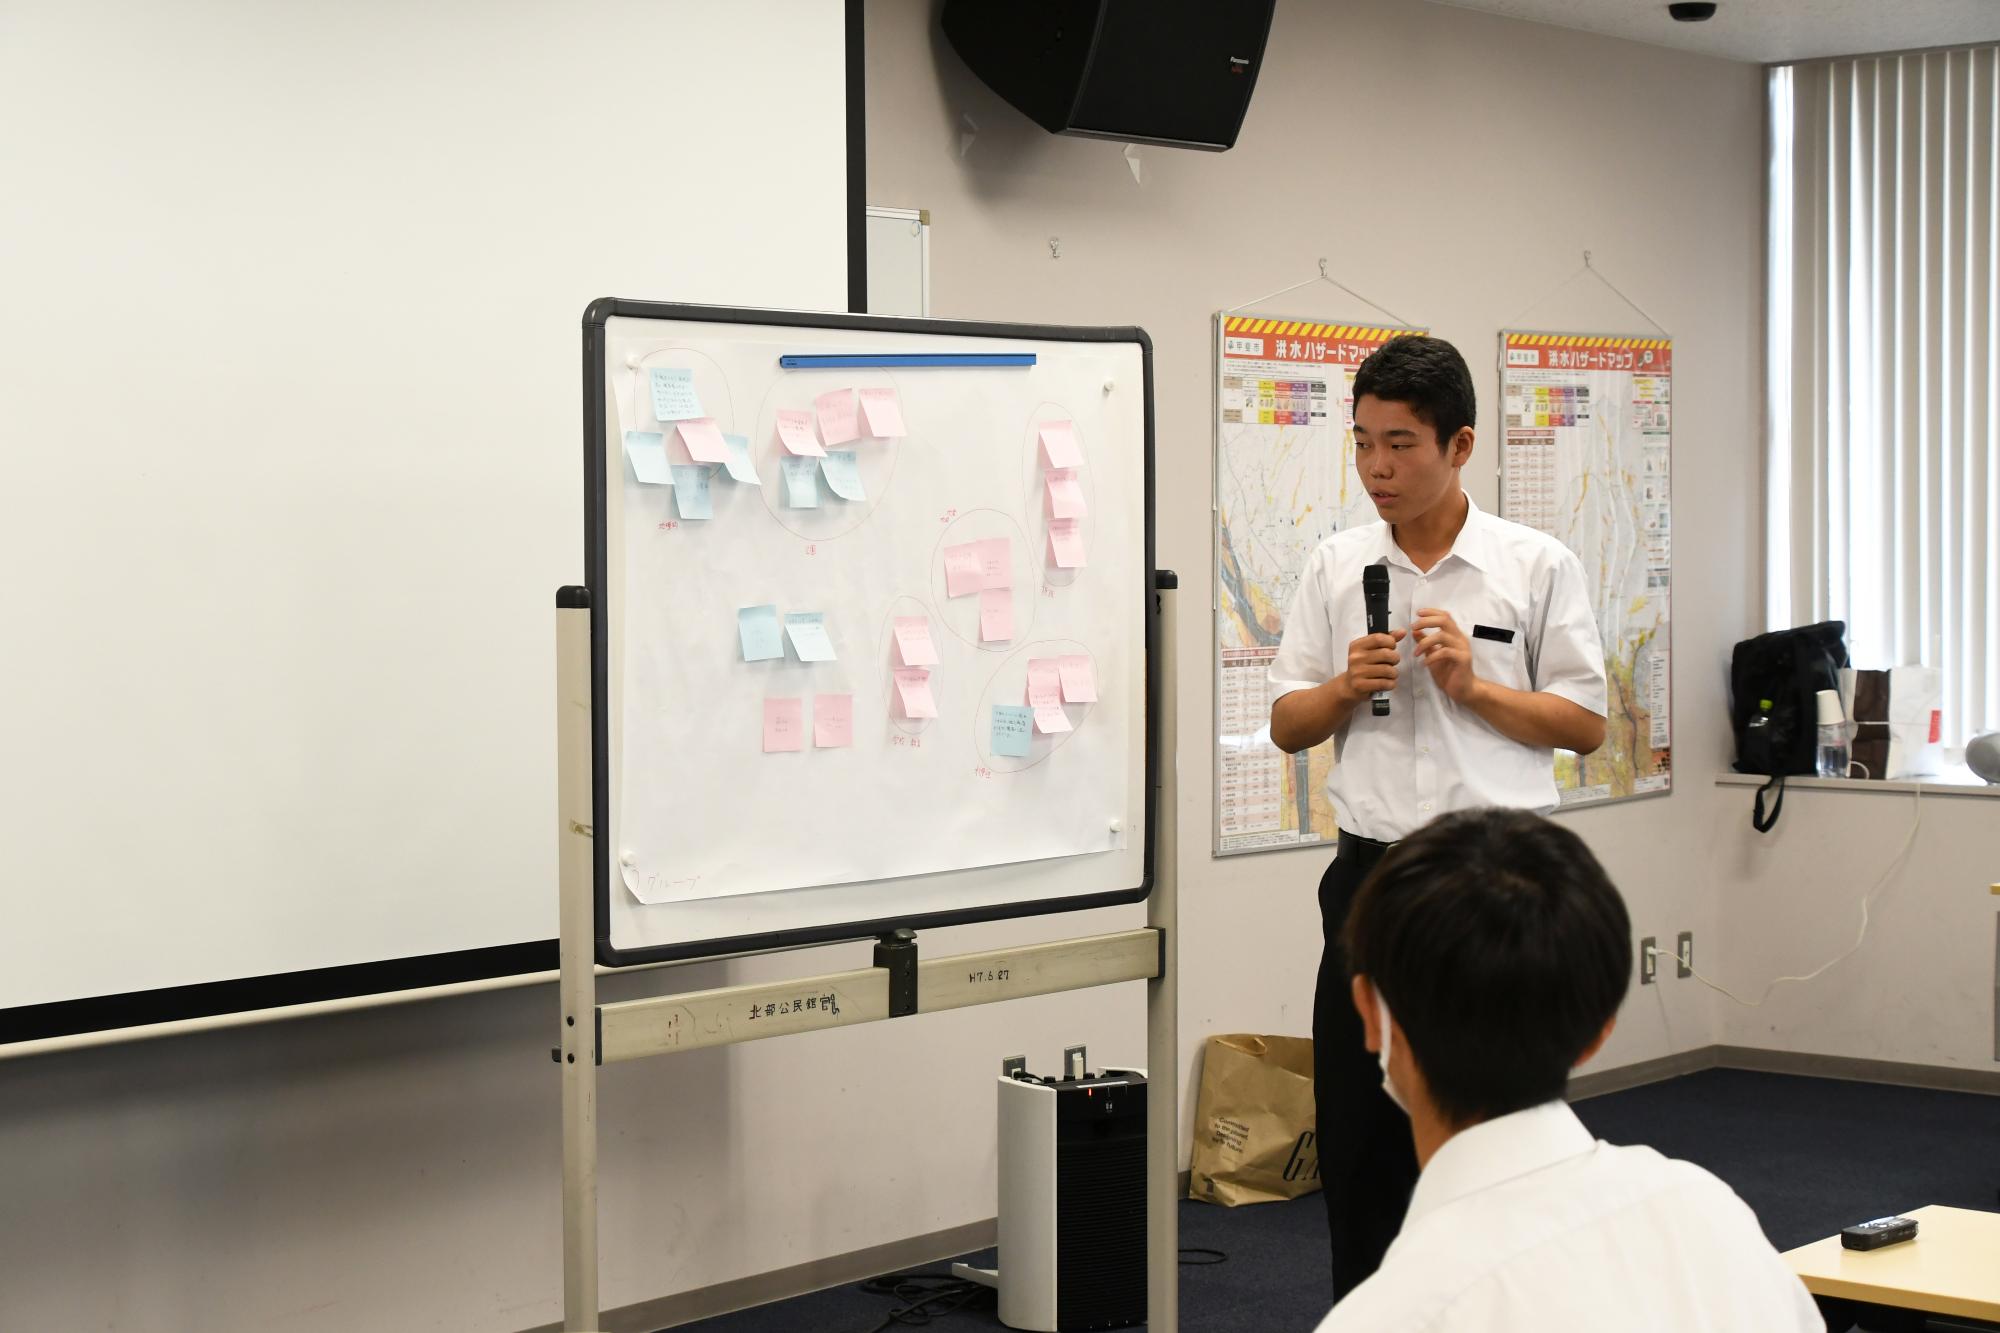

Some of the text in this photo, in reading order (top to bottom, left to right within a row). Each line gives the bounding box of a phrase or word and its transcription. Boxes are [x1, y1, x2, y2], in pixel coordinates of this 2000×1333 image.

[1548, 349, 1634, 369] 洪水ハザードマップ
